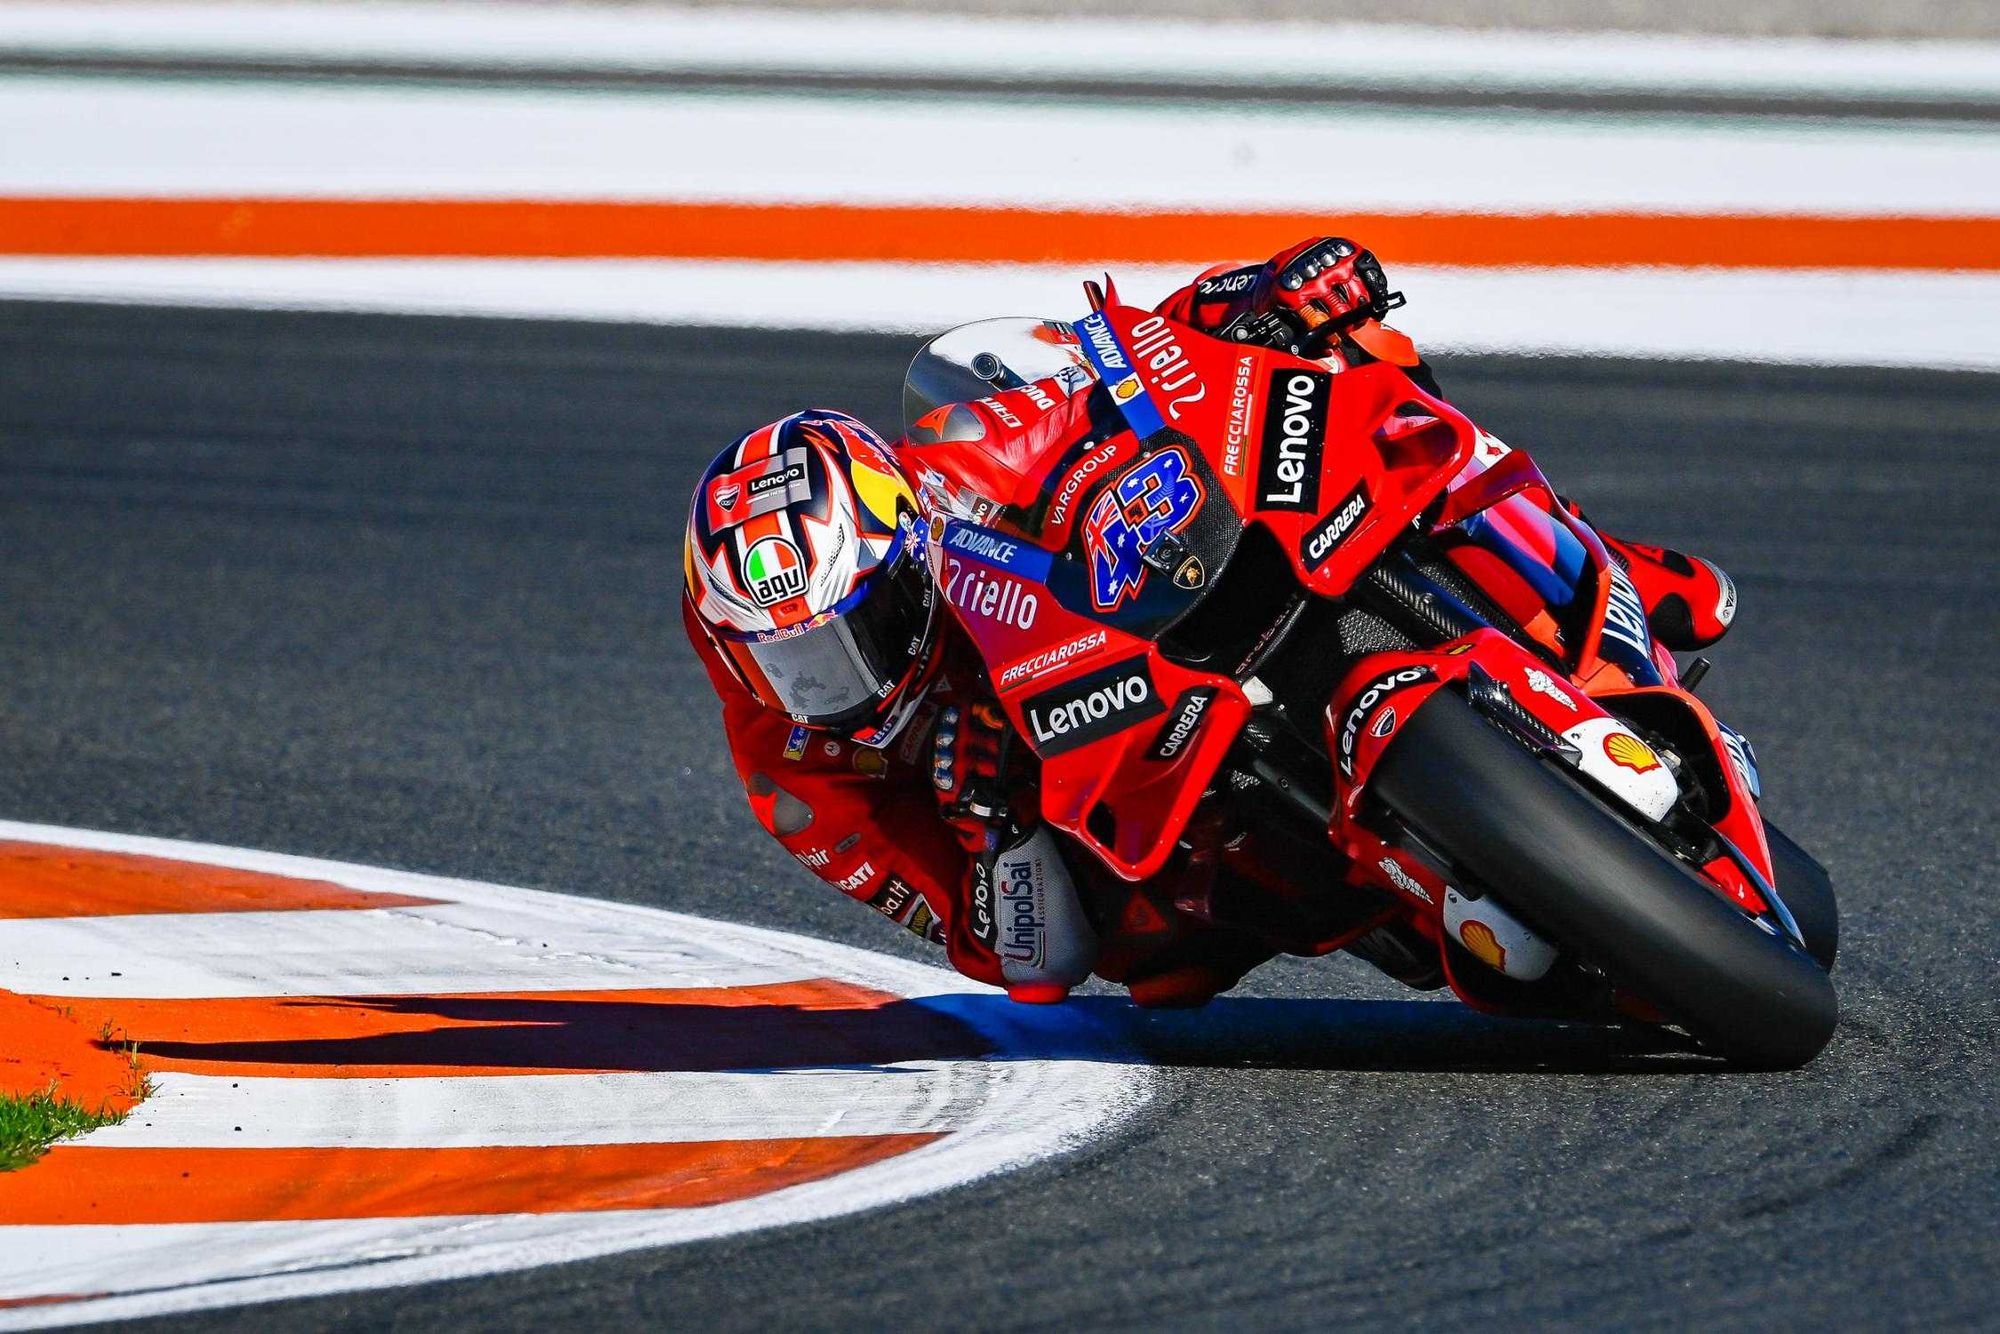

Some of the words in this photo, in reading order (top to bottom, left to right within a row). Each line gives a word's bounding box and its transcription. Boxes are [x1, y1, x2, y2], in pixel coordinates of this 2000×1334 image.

[1084, 313, 1127, 369] ADVANCE
[1223, 356, 1253, 476] FRECCIAROSSA
[1267, 374, 1315, 504] Lenovo
[751, 467, 800, 492] Lenovo
[1051, 445, 1118, 526] VARGROUP
[949, 528, 1018, 564] ADVANCE
[1084, 447, 1203, 609] 43
[1308, 494, 1366, 560] CARRERA
[758, 568, 800, 599] agv
[922, 588, 932, 608] CAT
[907, 635, 921, 656] CAT
[1000, 630, 1108, 686] FRECCIAROSSA
[877, 680, 896, 699] CAT
[1030, 675, 1149, 743] Lenovo
[792, 713, 809, 724] CAT
[1160, 694, 1208, 758] CARRERA
[1340, 670, 1422, 777] Lenovo
[838, 861, 876, 891] CATI
[1001, 861, 1045, 962] UnipolSai
